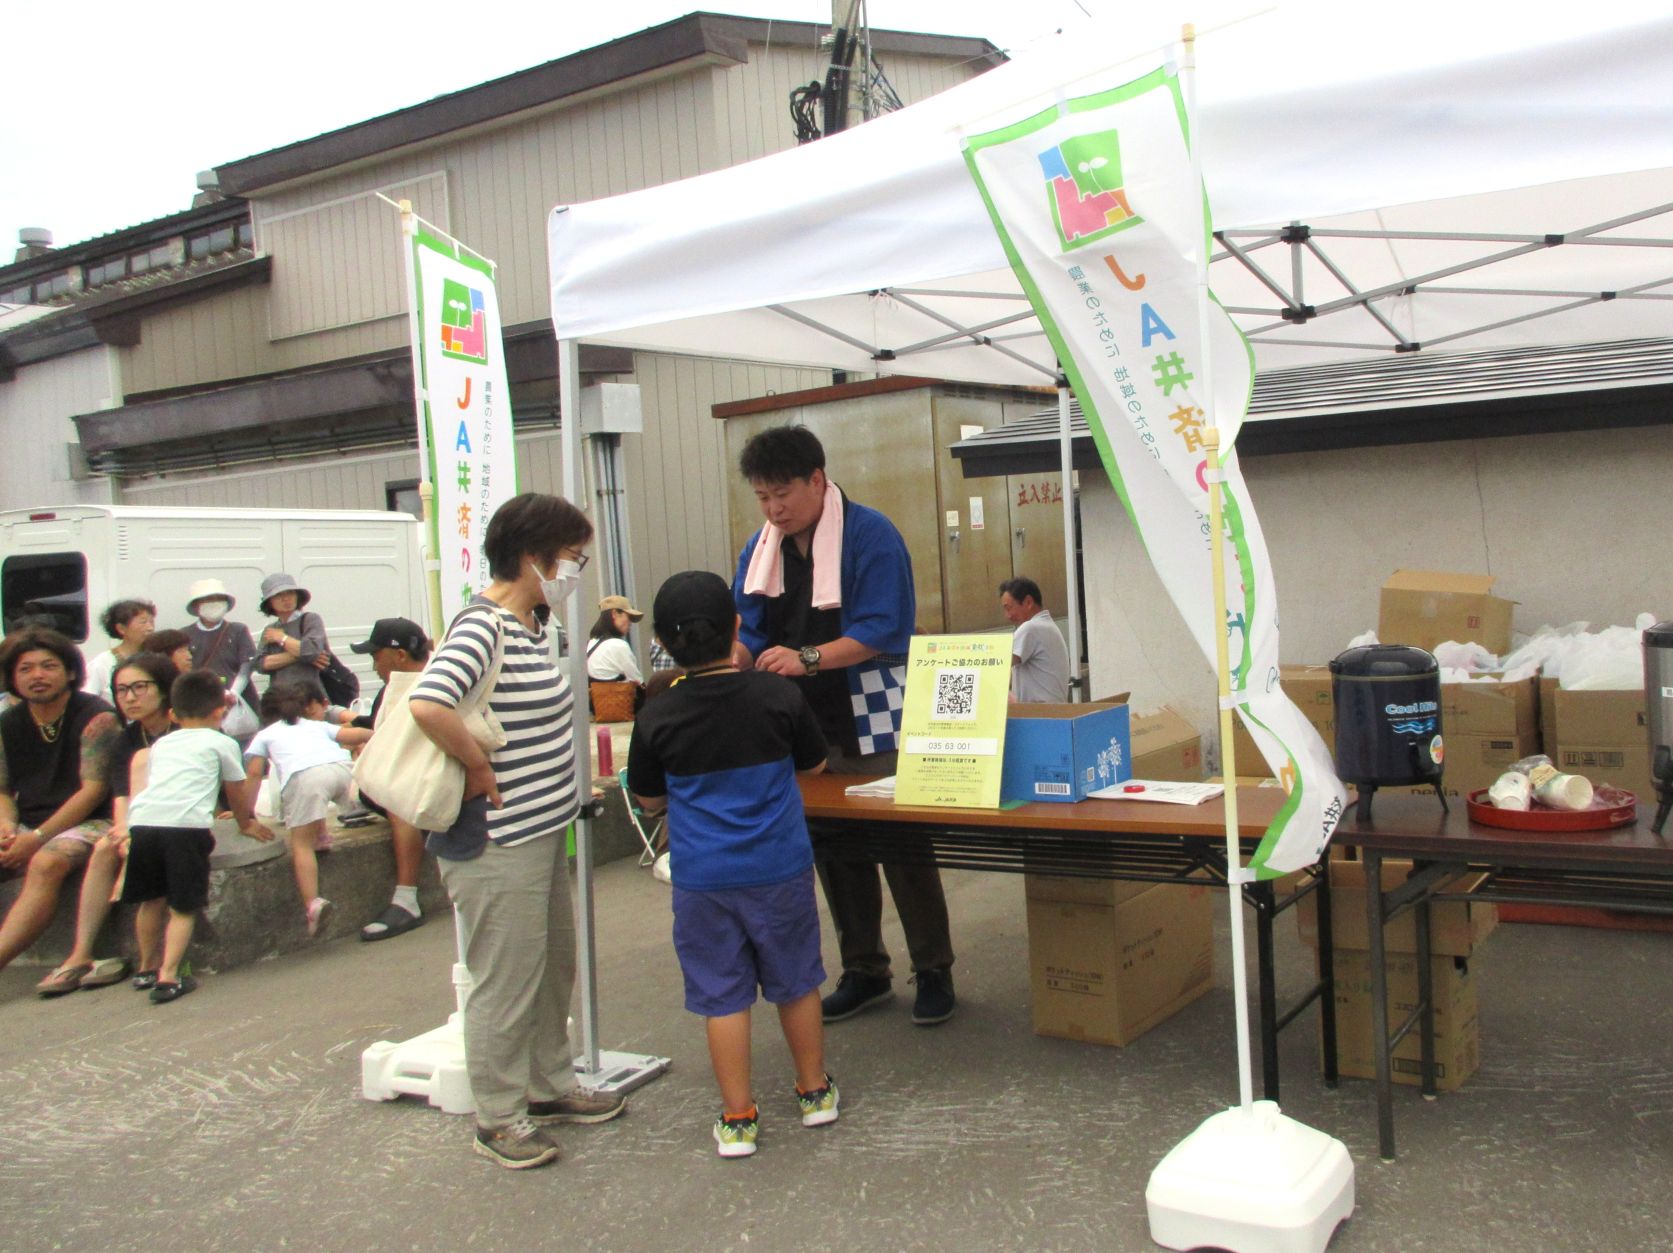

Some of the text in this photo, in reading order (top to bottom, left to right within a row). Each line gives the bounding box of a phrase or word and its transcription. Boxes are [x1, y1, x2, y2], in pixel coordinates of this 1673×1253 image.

[482, 380, 493, 455] 農業のために
[1017, 481, 1063, 507] 立入禁止
[915, 658, 1004, 667] アンケートご協力のお願い
[1385, 703, 1418, 714] Cool
